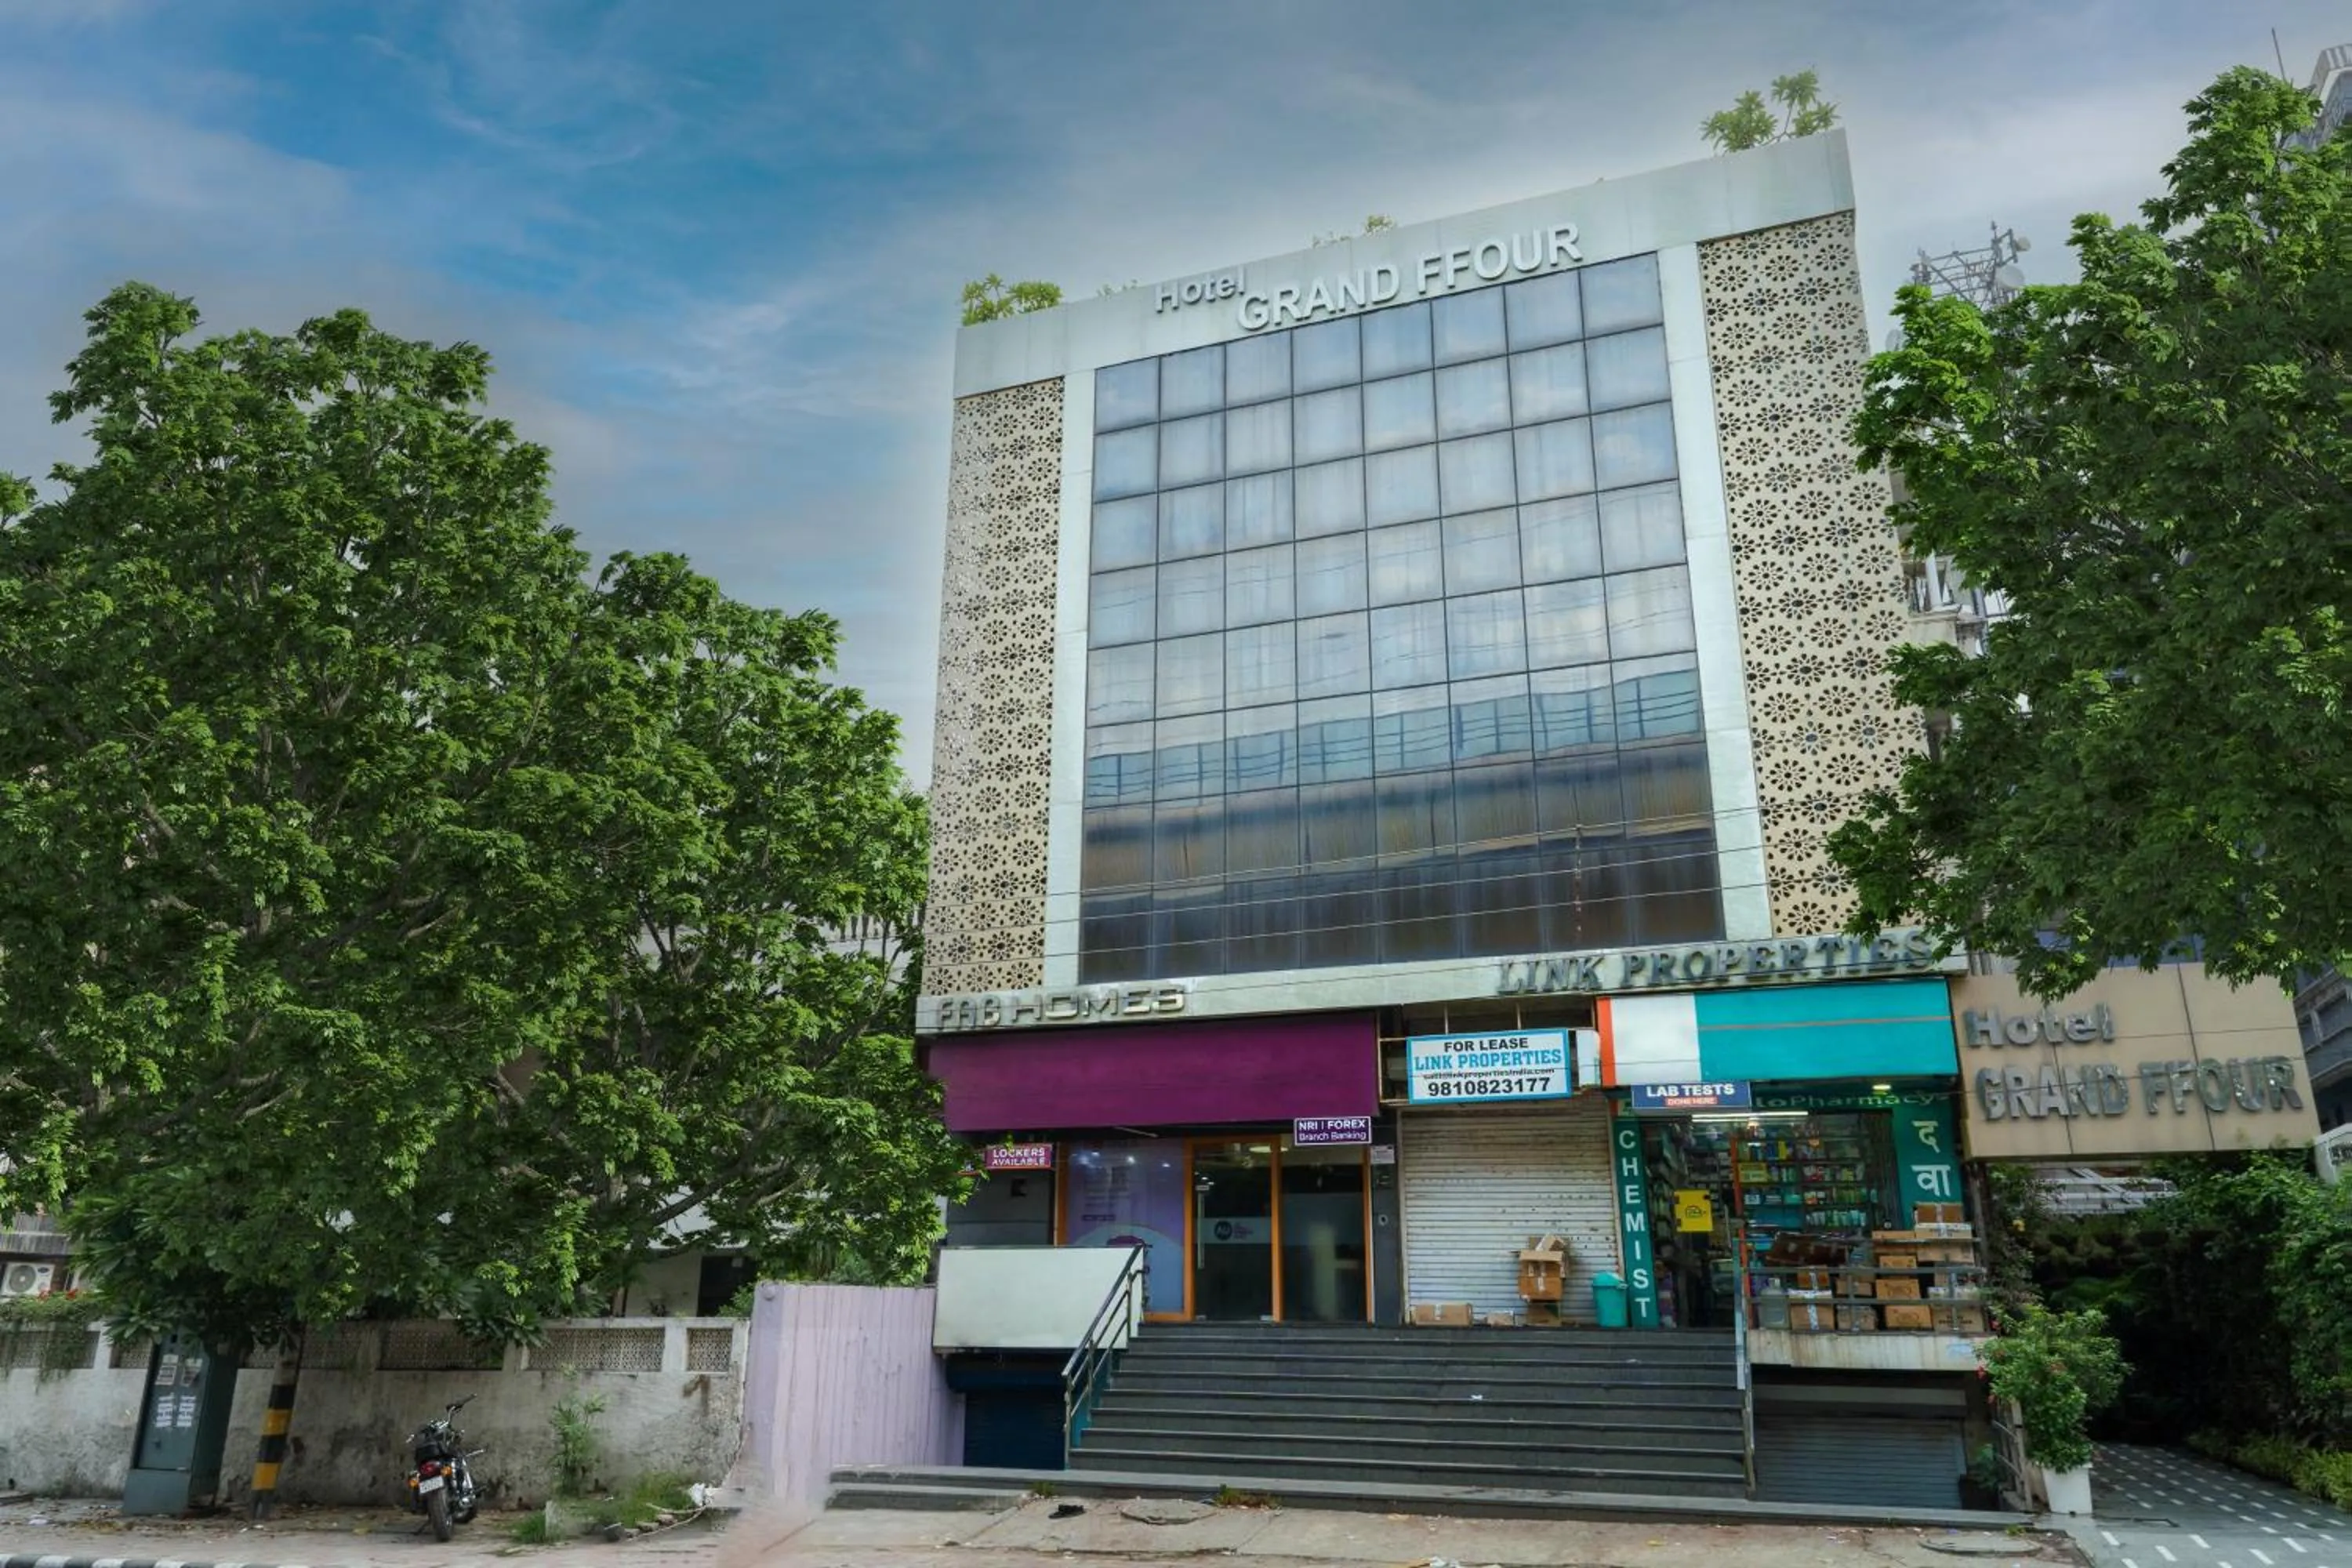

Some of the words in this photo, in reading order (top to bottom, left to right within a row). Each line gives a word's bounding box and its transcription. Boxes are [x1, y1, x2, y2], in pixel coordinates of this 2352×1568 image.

[1237, 263, 1400, 332] GRAND
[1417, 223, 1583, 296] FFOUR
[1155, 266, 1247, 314] Hotel
[1497, 955, 1605, 995] LINK
[1619, 930, 1934, 989] PROPERTIES
[1012, 987, 1185, 1022] HOMES
[1964, 1002, 2115, 1047] Hotel
[1444, 1040, 1475, 1052] FOR
[1479, 1037, 1529, 1051] LEASE
[1414, 1055, 1453, 1071] LINK
[1458, 1049, 1562, 1069] PROPERTIES
[1428, 1076, 1551, 1096] 9810823177
[1647, 1086, 1679, 1098] LAB
[1681, 1083, 1735, 1096] TESTS
[1976, 1063, 2129, 1121] GRAND
[2138, 1055, 2304, 1113] FFOUR
[1298, 1120, 1319, 1131] NRI
[1327, 1119, 1366, 1130] FOREX
[1299, 1131, 1330, 1141] Branch
[1331, 1131, 1367, 1141] Banking
[992, 1157, 1045, 1166] AVAILABLE
[993, 1147, 1045, 1159] LOCKERS
[1619, 1130, 1650, 1318] CHEMIST
